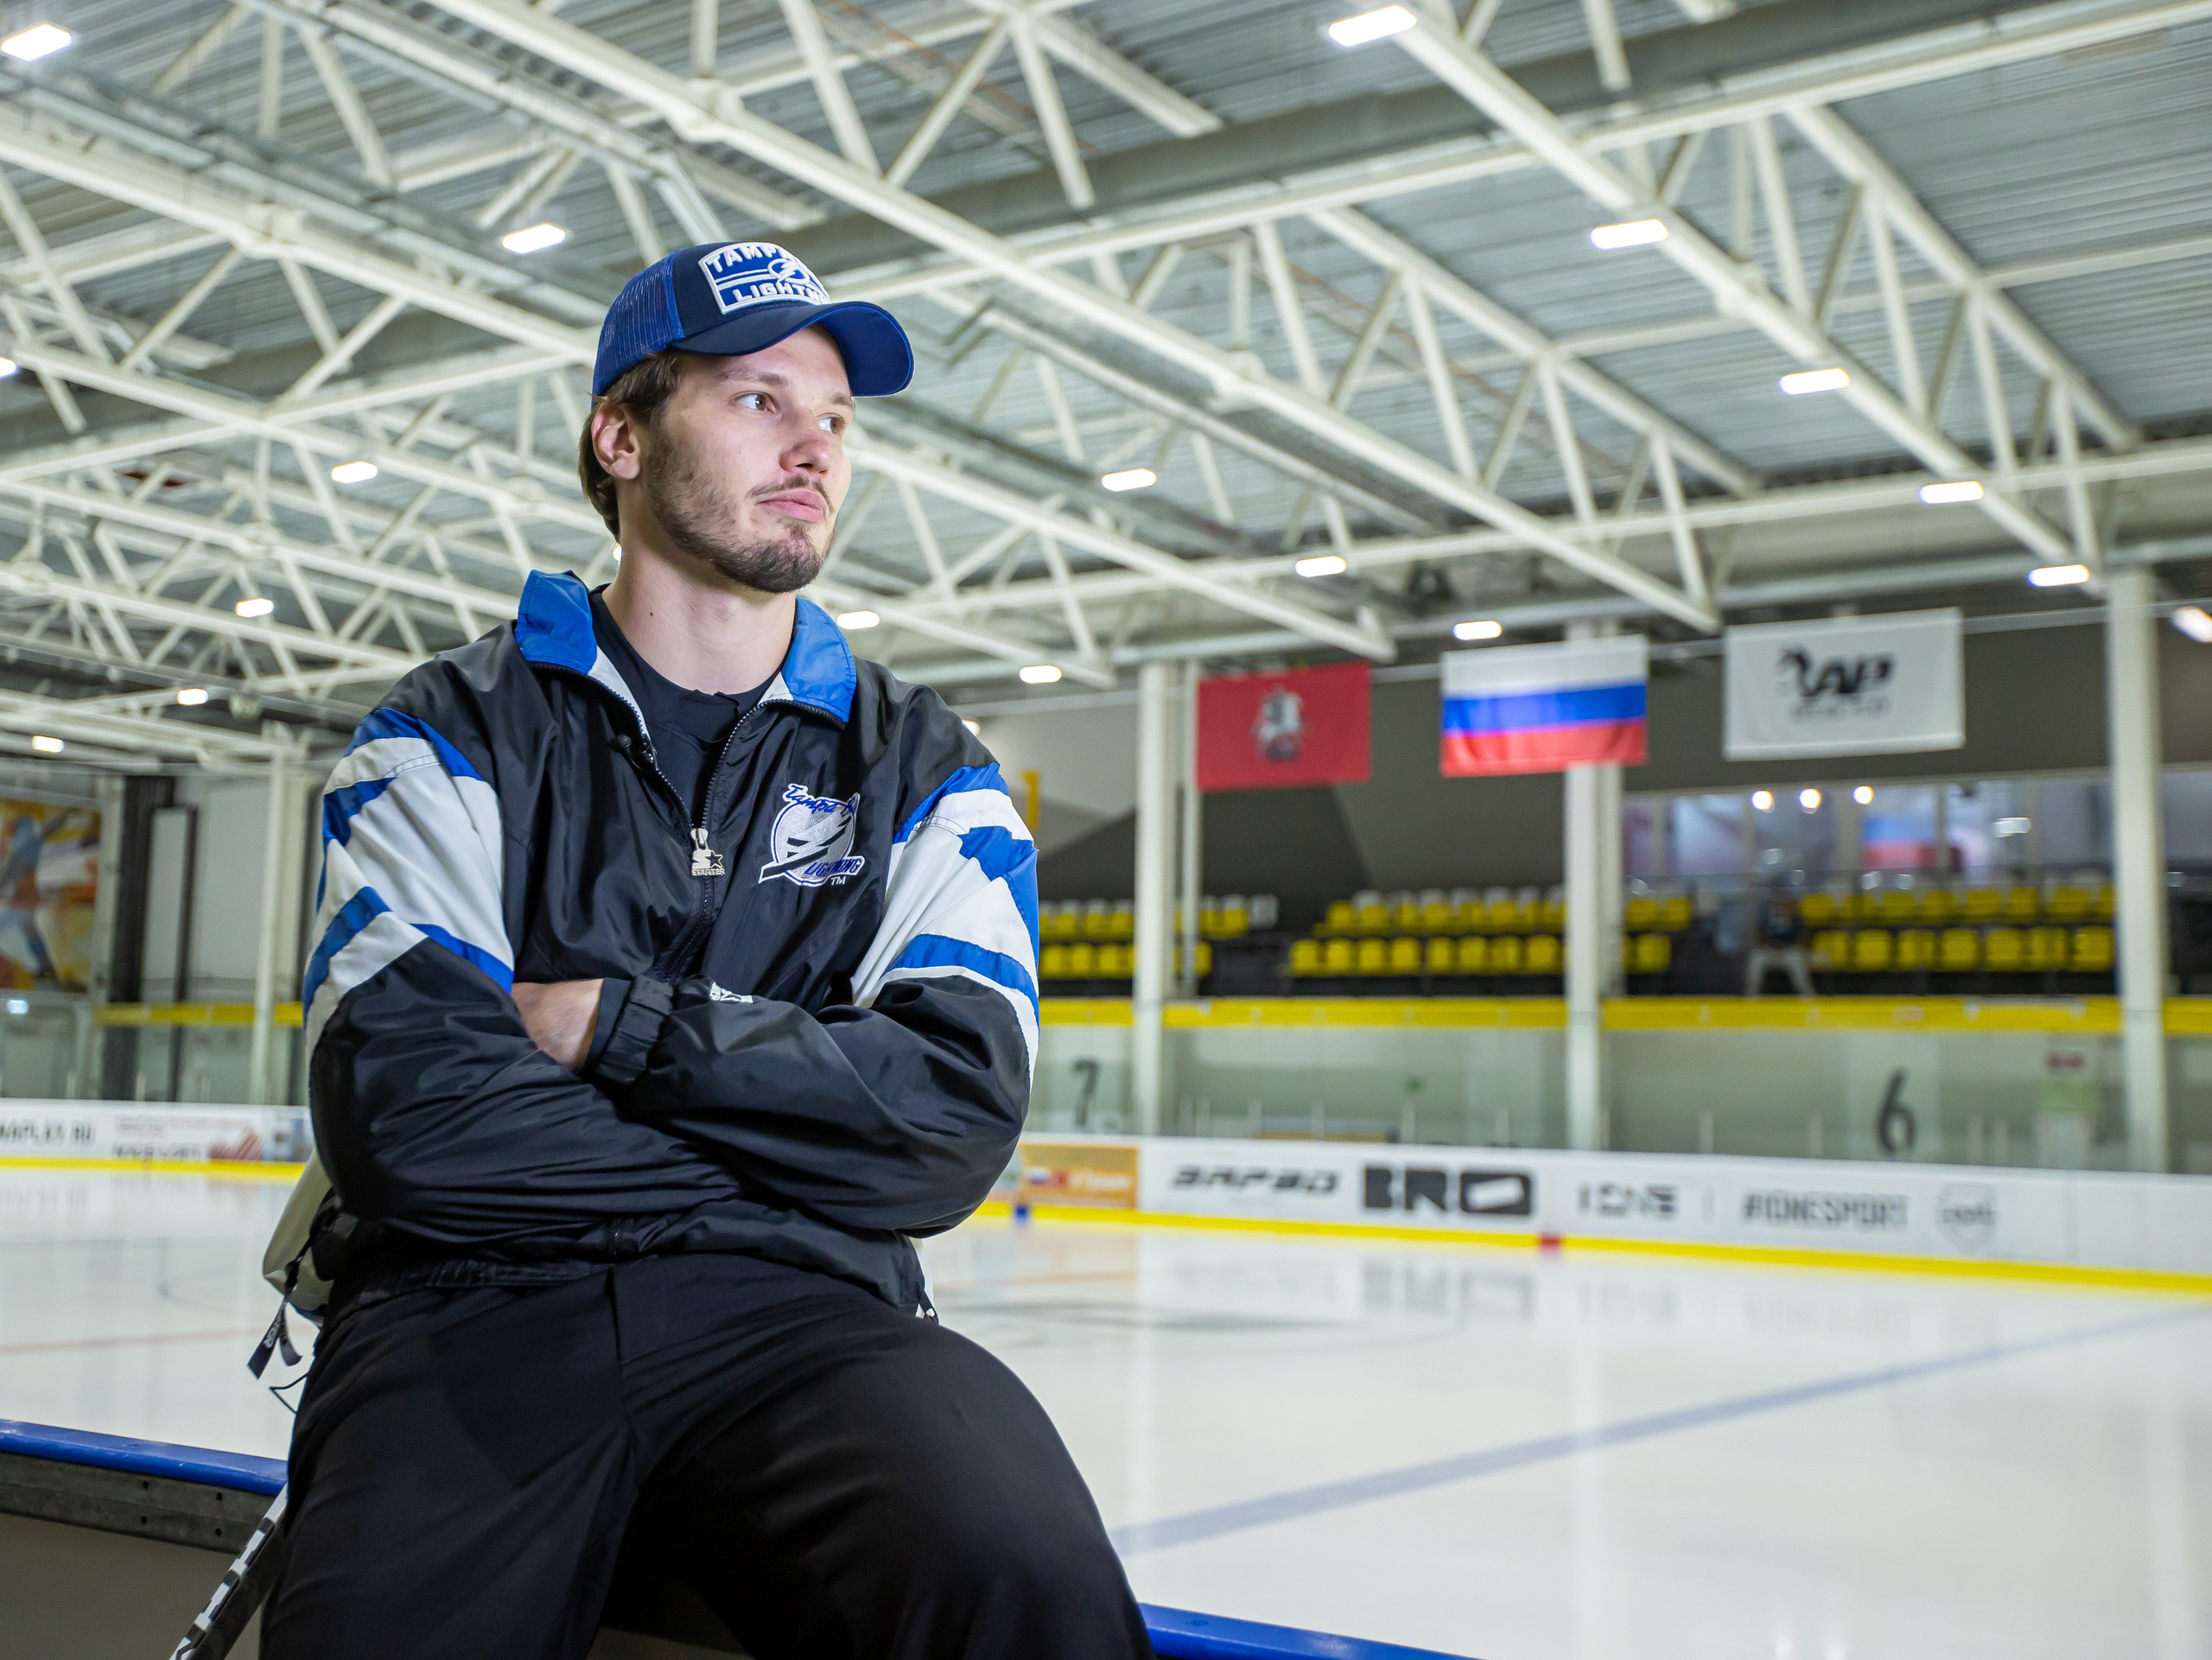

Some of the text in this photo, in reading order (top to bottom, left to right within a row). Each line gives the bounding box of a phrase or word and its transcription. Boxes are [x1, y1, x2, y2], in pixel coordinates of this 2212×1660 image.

[831, 876, 846, 886] TM
[1071, 1058, 1101, 1128] 7
[1876, 1066, 1916, 1154] 6
